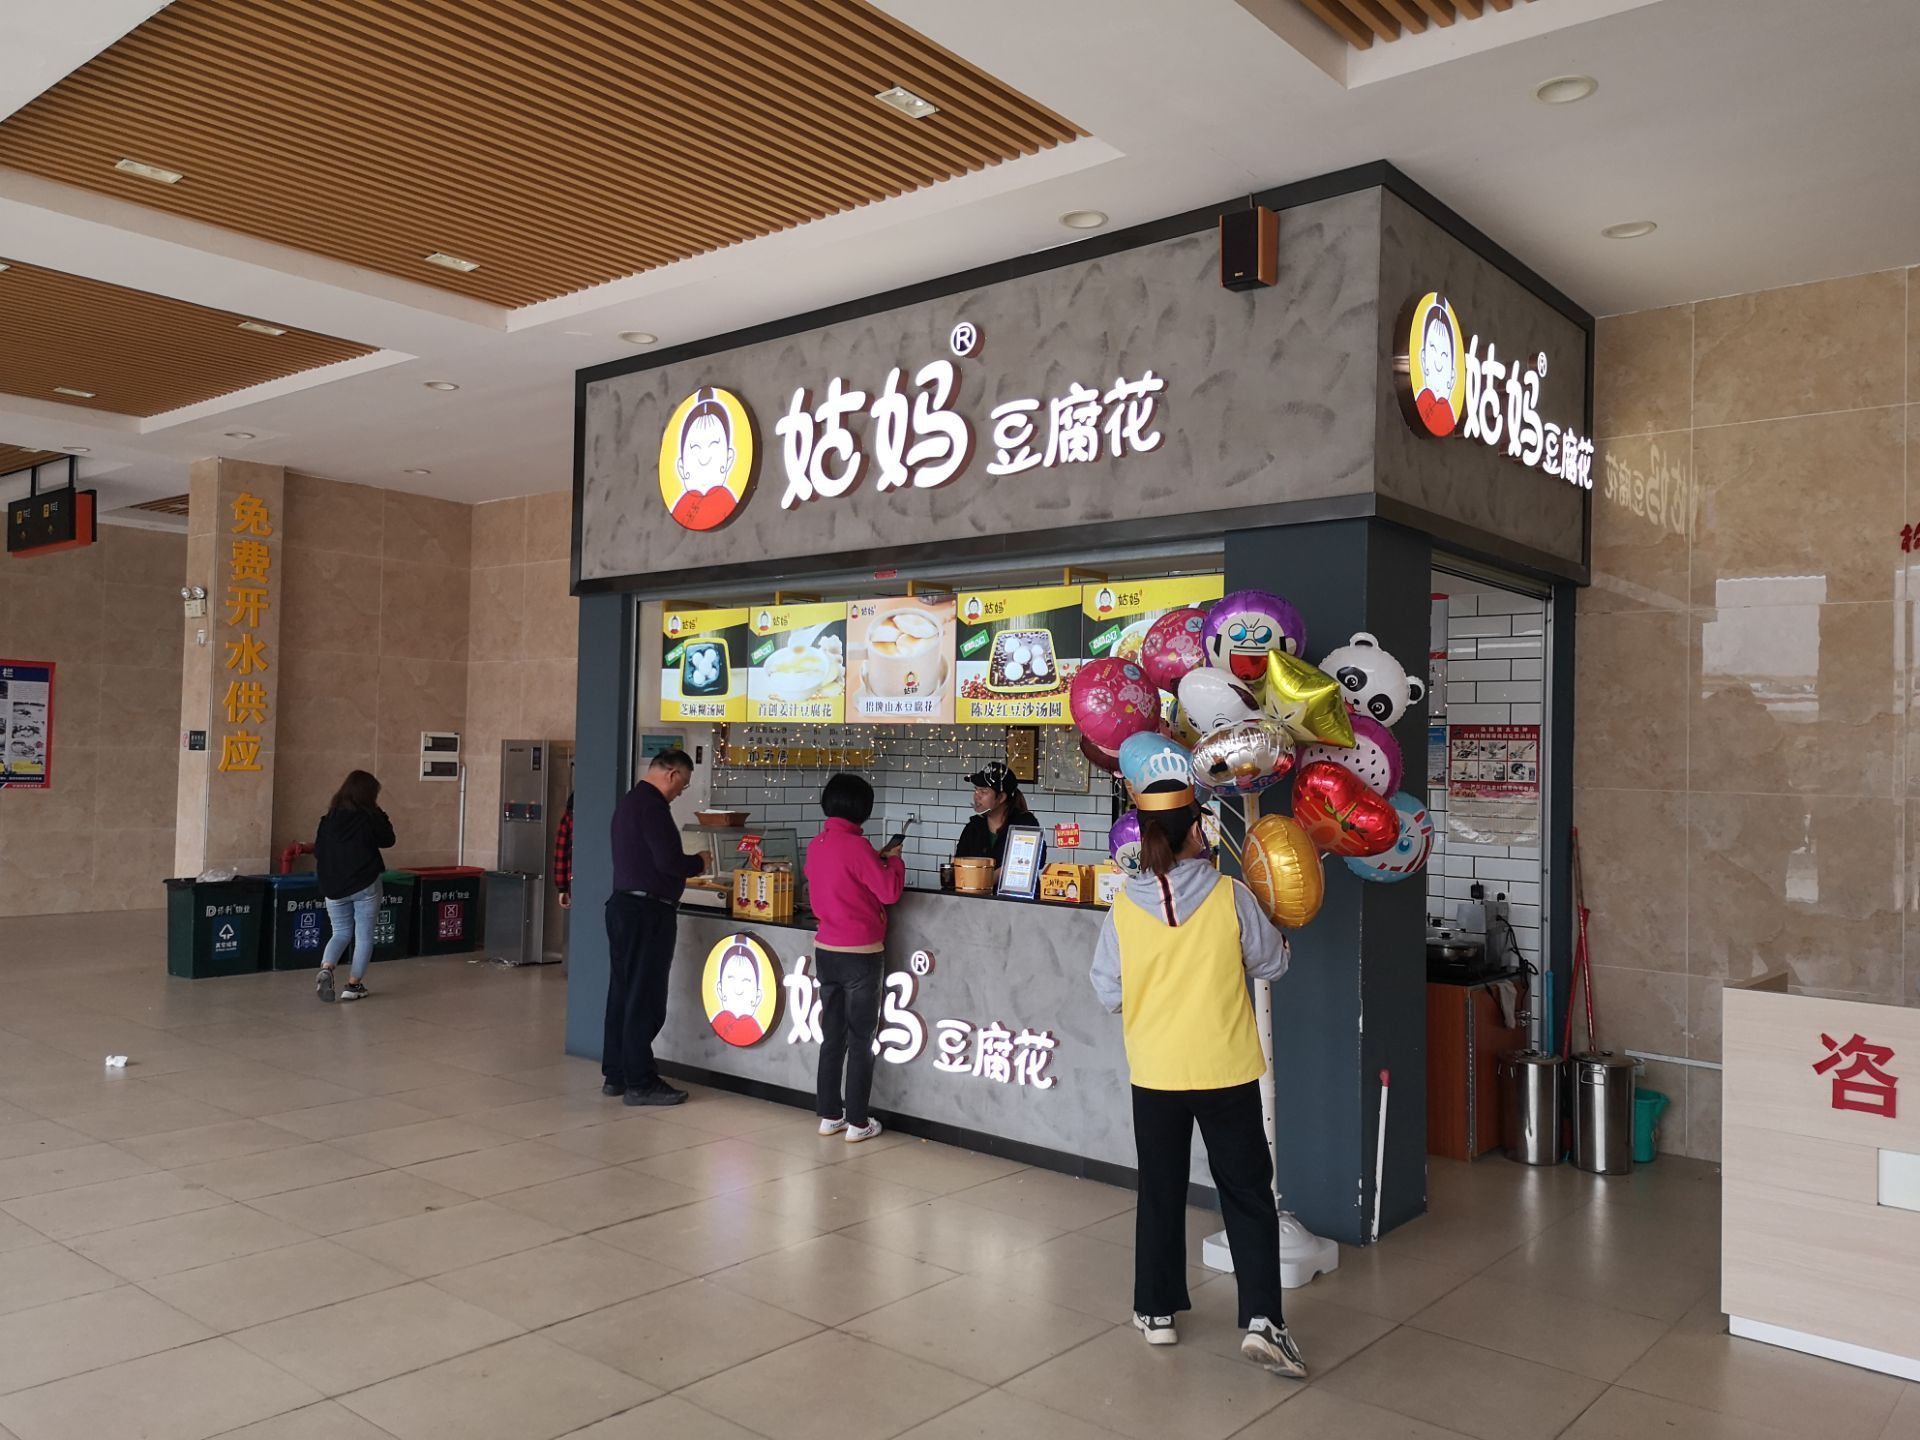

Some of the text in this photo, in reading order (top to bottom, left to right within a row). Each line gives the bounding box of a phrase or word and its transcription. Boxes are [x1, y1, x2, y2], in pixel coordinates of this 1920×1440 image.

[775, 358, 969, 510] 姑妈
[985, 370, 1164, 476] 豆腐花
[1463, 334, 1543, 466] 姑妈
[1542, 422, 1595, 490] 豆腐花
[218, 492, 273, 773] 免费开水供应
[758, 704, 832, 717] 首创姜汁豆腐花
[865, 701, 932, 713] 招牌山水豆腐花
[970, 702, 1062, 717] 陈皮红豆沙汤圆
[933, 1019, 1054, 1089] 豆腐花
[1812, 1032, 1899, 1118] 咨
